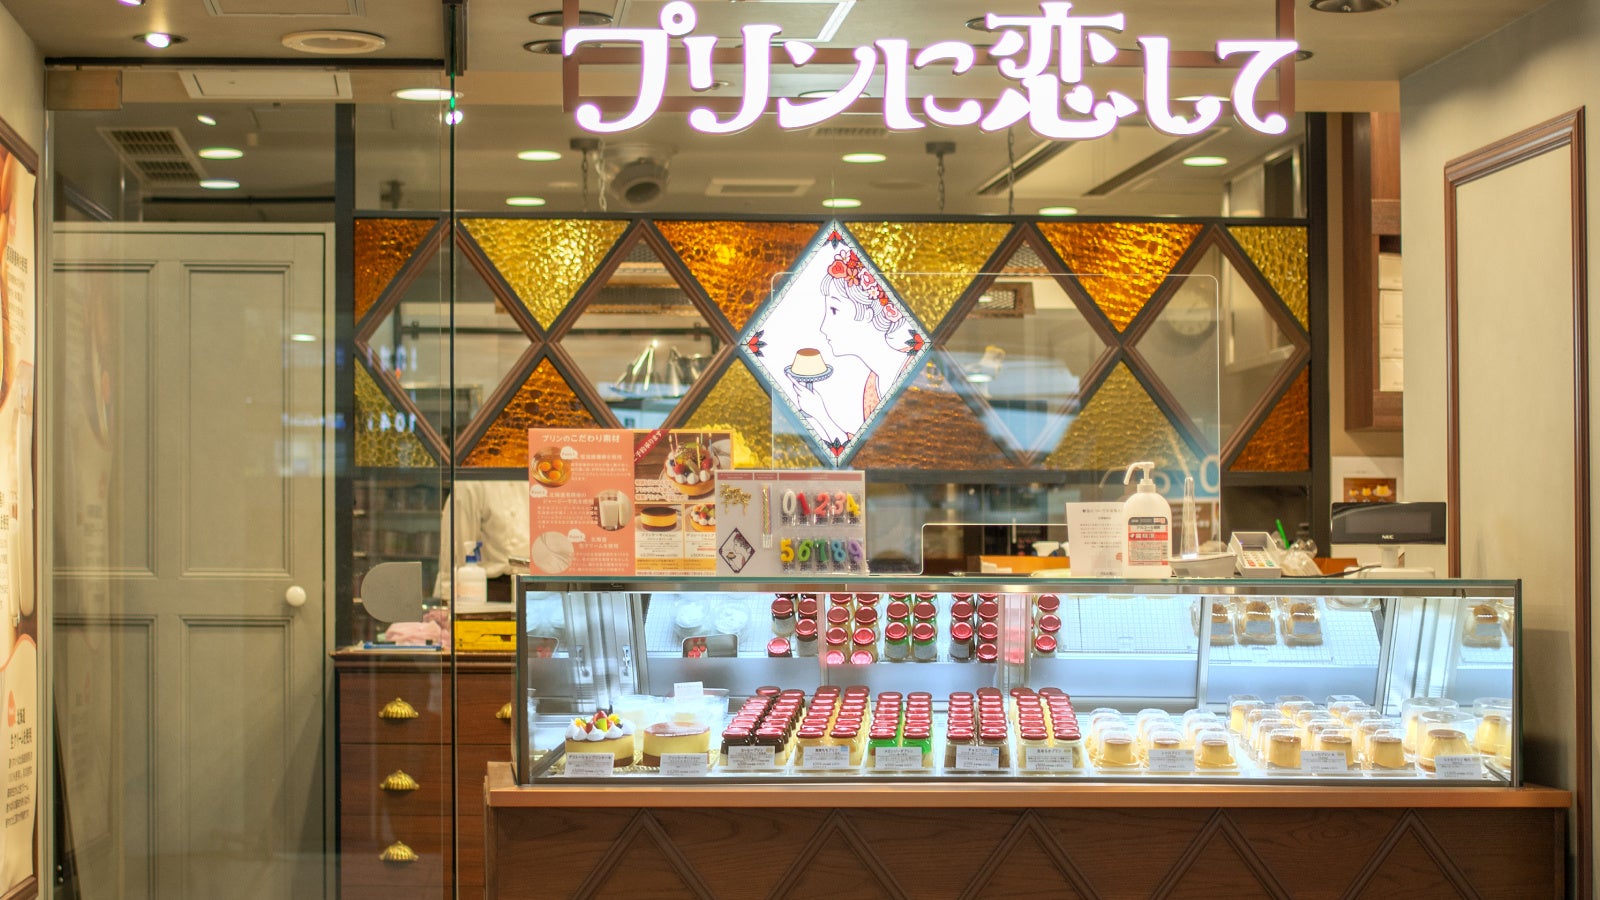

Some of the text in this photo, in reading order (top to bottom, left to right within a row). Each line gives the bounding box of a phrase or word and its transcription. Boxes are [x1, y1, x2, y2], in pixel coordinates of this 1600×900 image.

[563, 1, 1299, 138] プリンに恋して
[542, 434, 620, 443] プリンのこだわり素材
